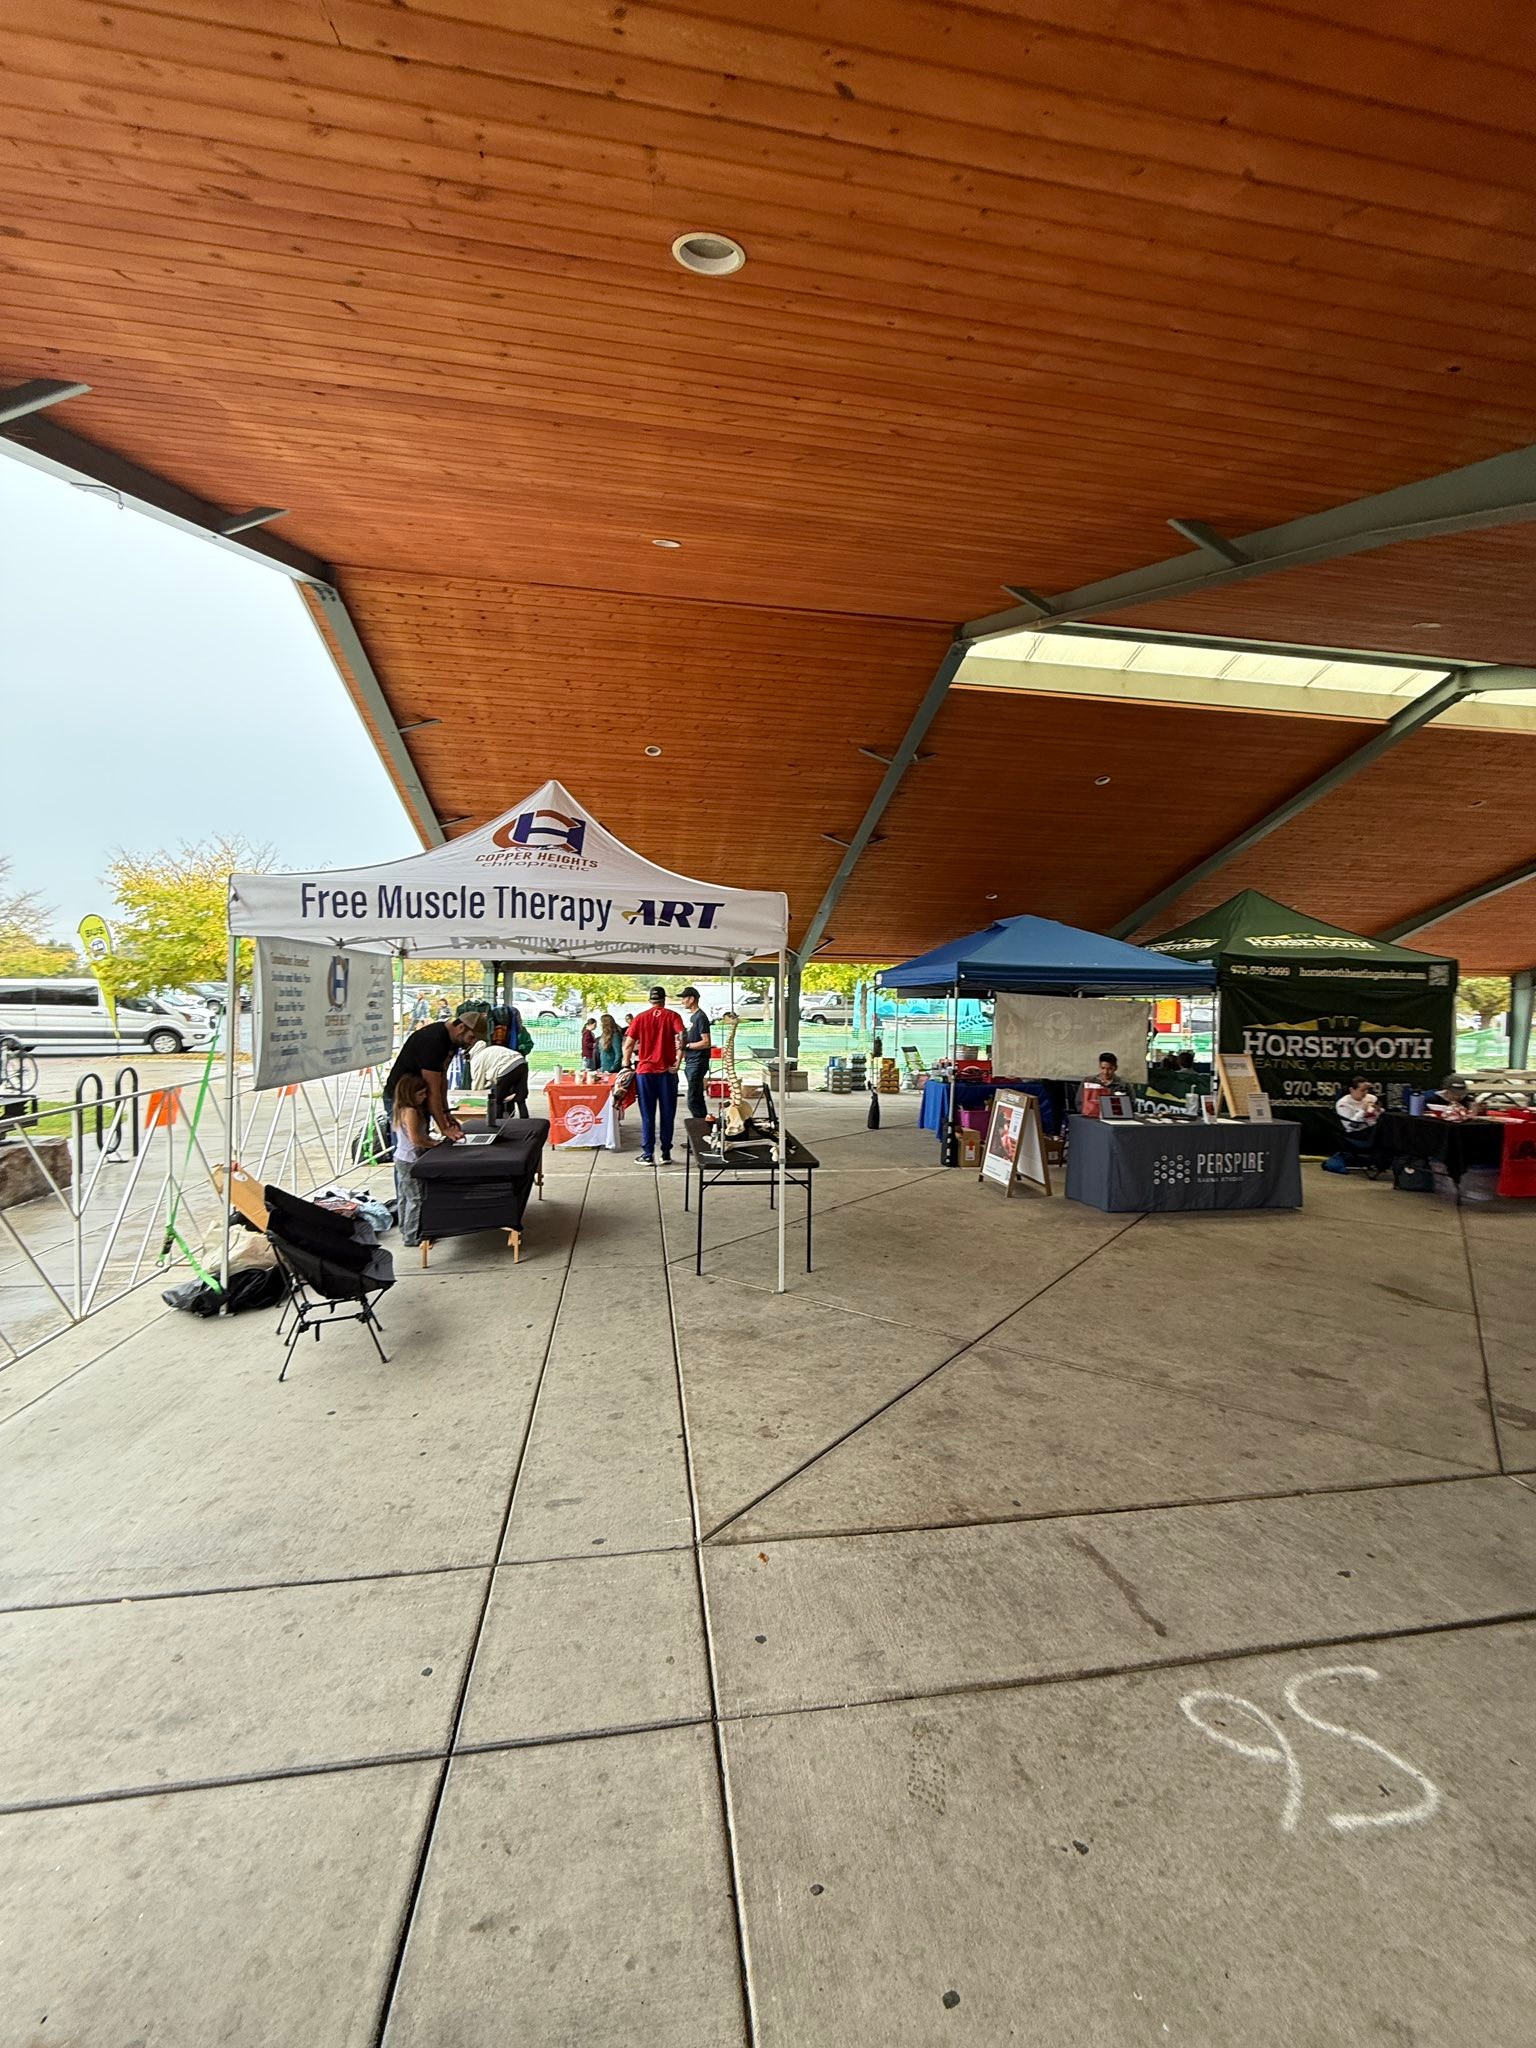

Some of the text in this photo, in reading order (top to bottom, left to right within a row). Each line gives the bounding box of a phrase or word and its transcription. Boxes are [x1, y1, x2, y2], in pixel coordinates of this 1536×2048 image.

[475, 852, 598, 868] COPPER HEIGHTS
[481, 859, 590, 872] chiropractic
[301, 883, 726, 931] Free Muscle Therapy ART
[1245, 938, 1375, 949] HORSETOOTH
[1242, 1031, 1433, 1059] HORSETOOTH
[1255, 1058, 1308, 1072] EATING,
[1311, 1060, 1339, 1071] AIR
[1339, 1060, 1351, 1071] &
[1354, 1061, 1433, 1072] PLUMBING
[1197, 1151, 1265, 1174] PERSPIRE
